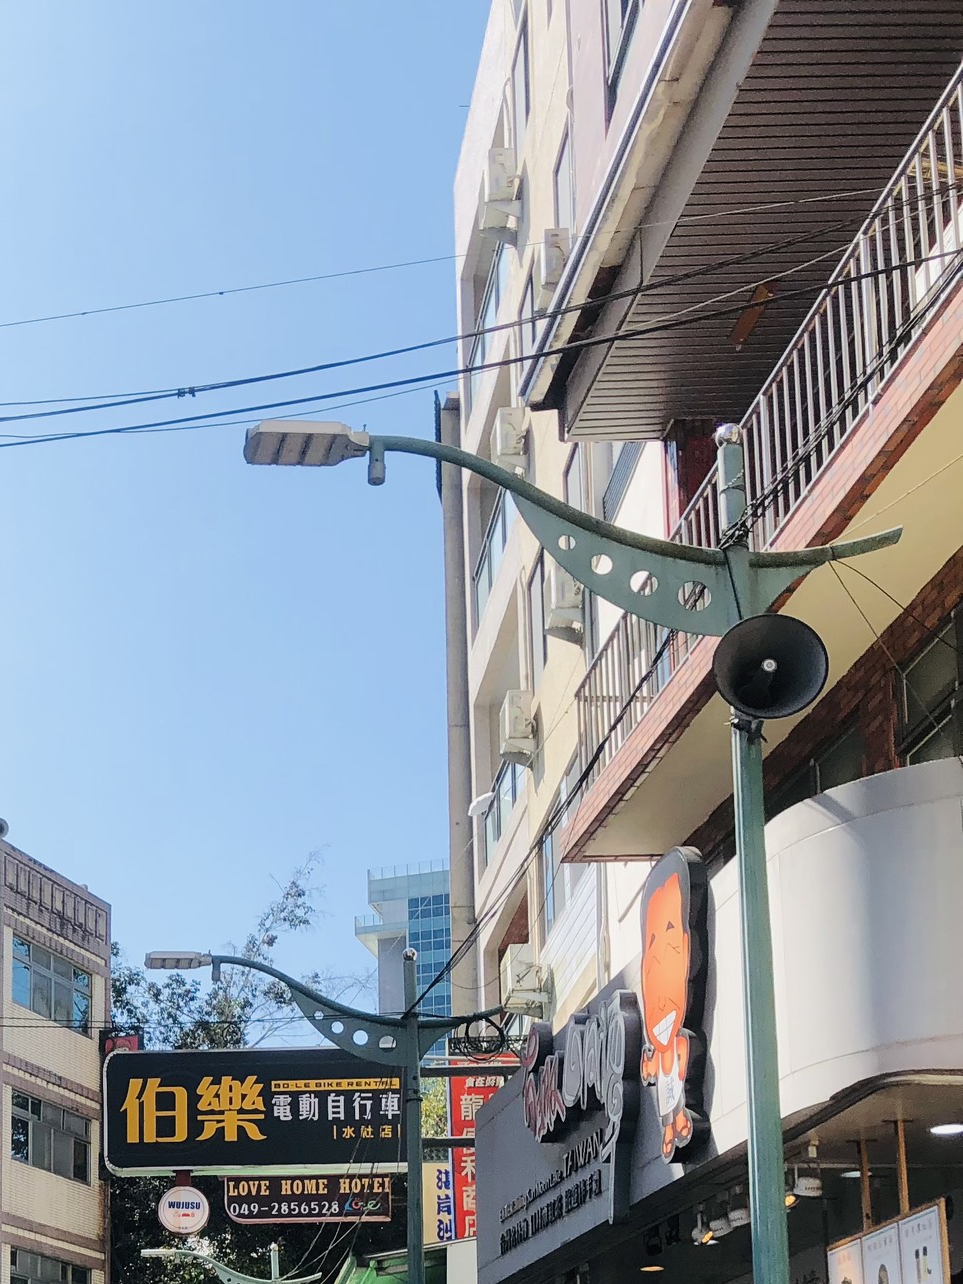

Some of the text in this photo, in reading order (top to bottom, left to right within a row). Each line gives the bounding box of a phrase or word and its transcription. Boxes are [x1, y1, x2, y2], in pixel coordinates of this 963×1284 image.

[119, 1075, 268, 1144] 伯樂
[271, 1091, 401, 1121] 電動自行車
[342, 1125, 392, 1139] 水社店
[228, 1180, 270, 1196] LOVE
[281, 1178, 328, 1195] HOME
[168, 1200, 201, 1210] WUJUSU
[230, 1201, 340, 1215] 049-2856528
